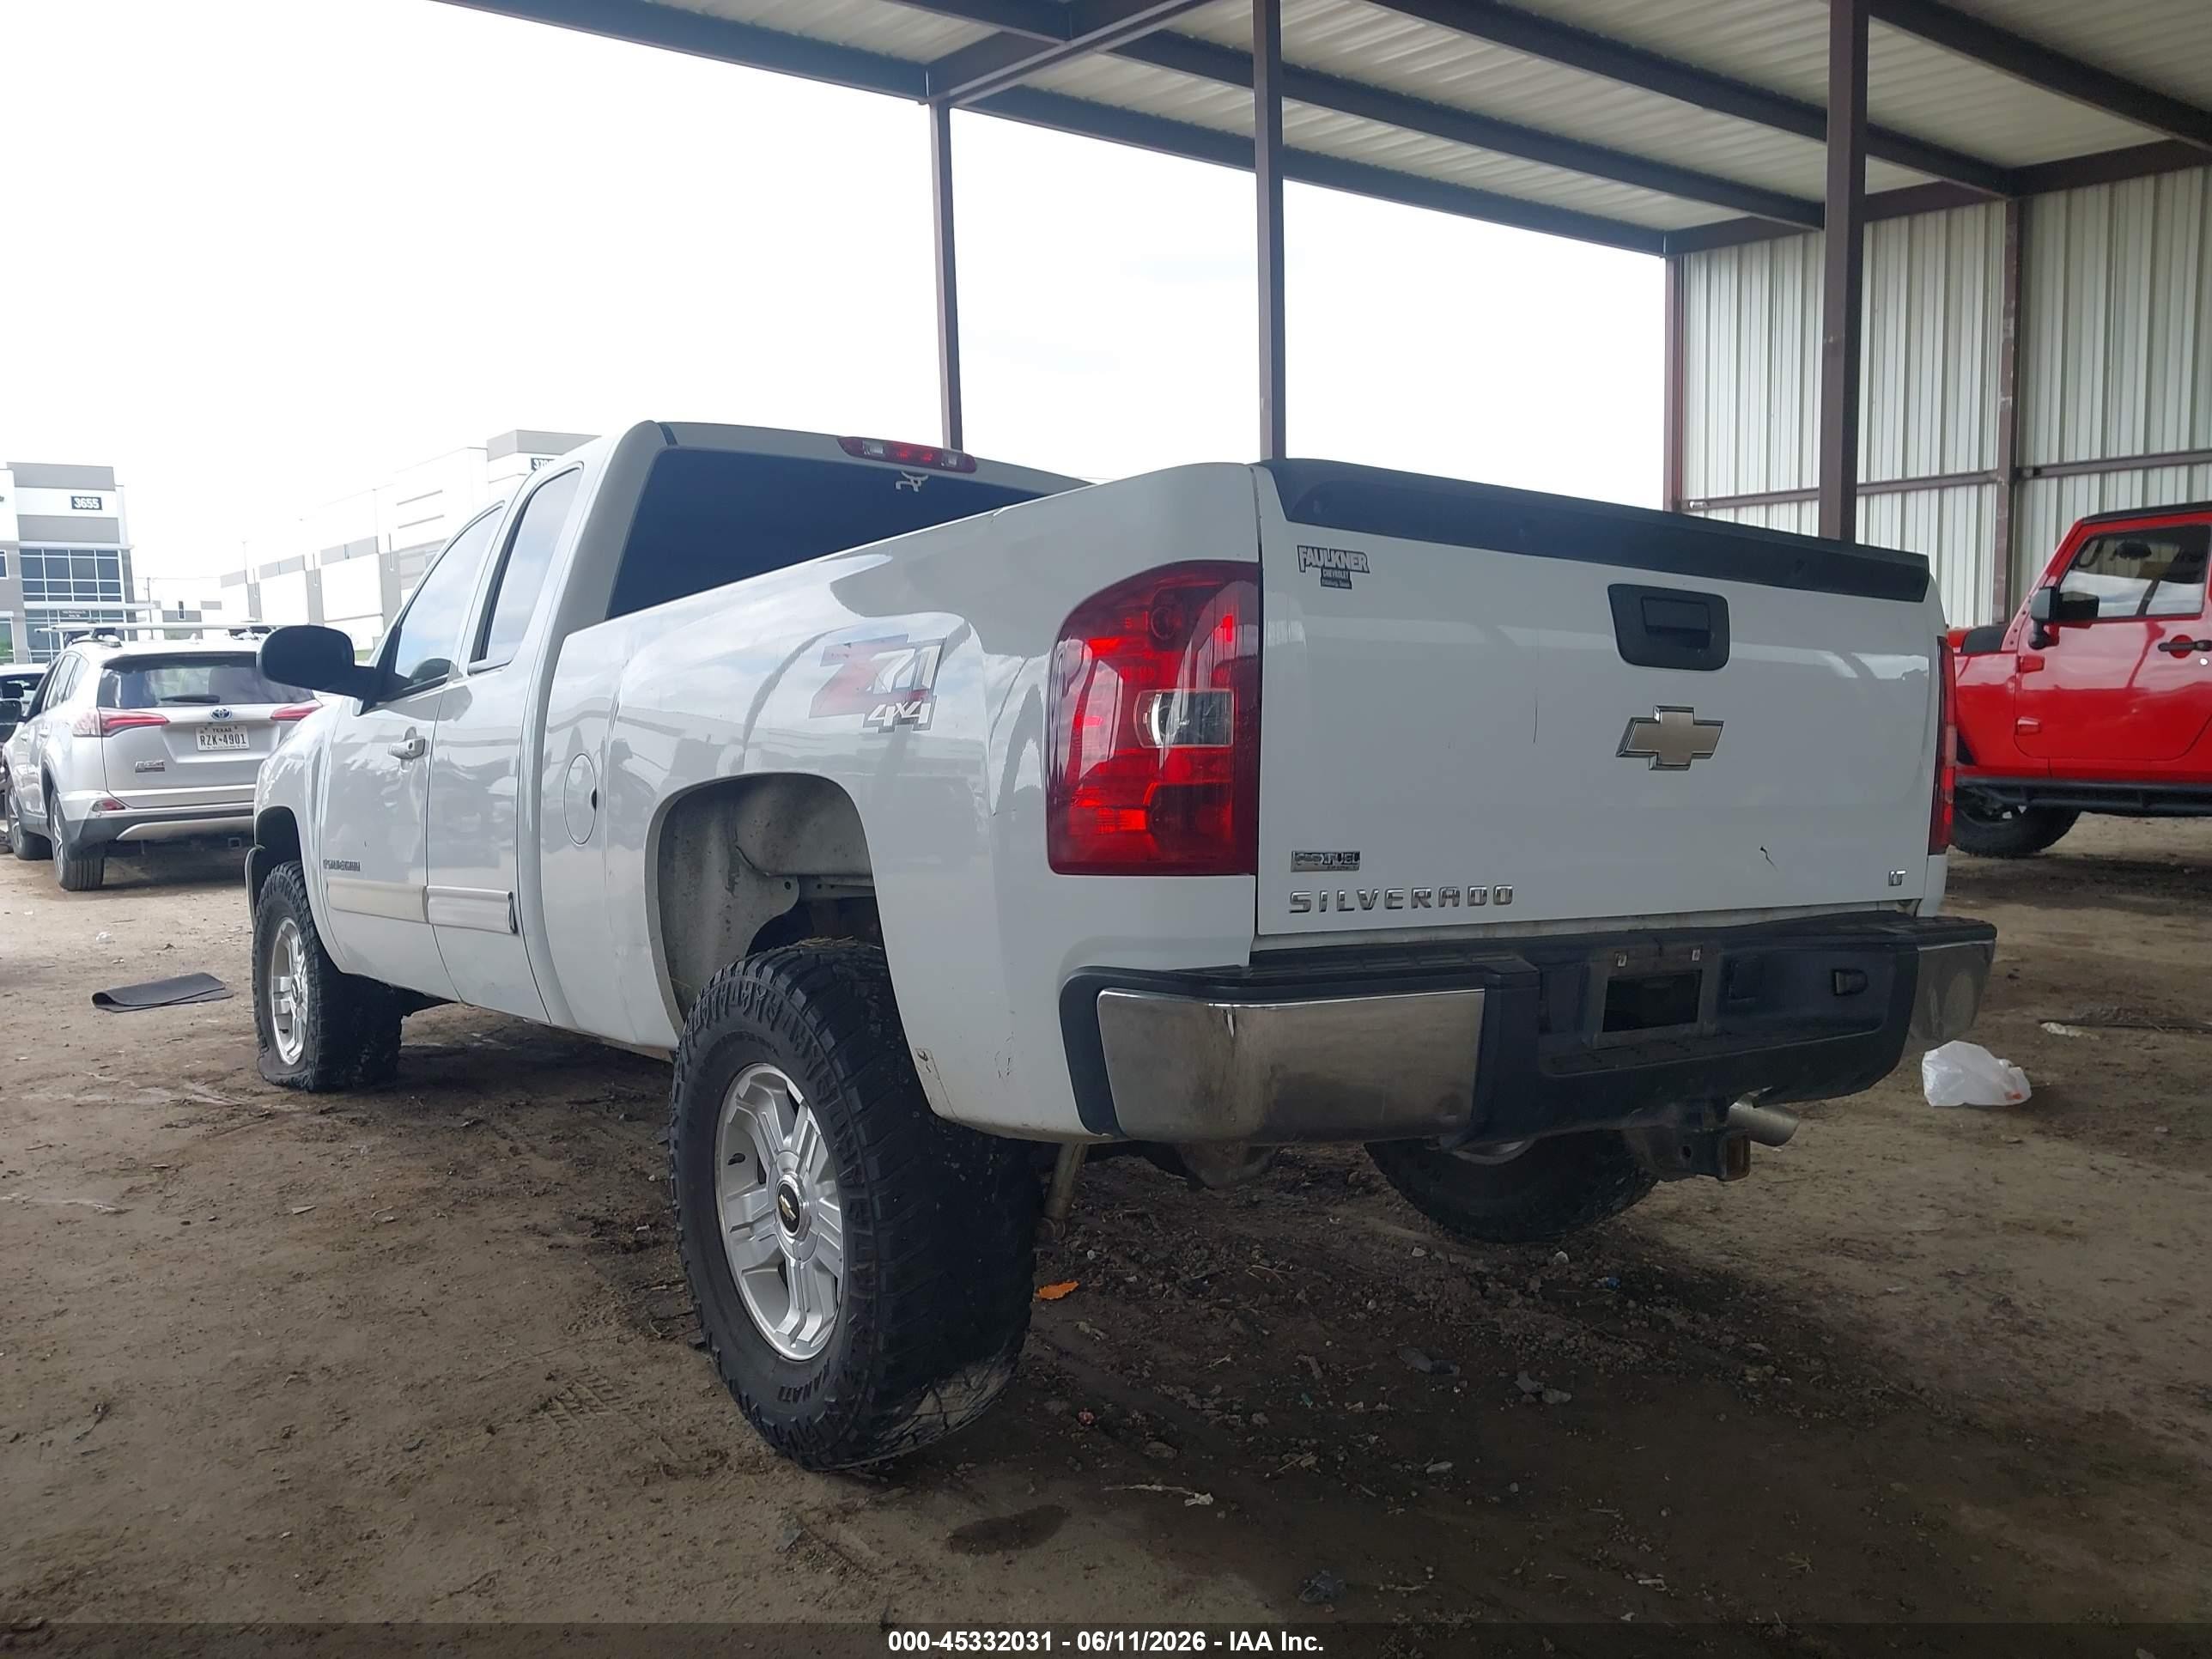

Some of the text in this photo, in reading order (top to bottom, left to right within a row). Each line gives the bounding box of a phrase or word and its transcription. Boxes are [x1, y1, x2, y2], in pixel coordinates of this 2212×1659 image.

[73, 496, 100, 509] 3655
[1297, 544, 1370, 573] FAULKNER
[809, 634, 945, 718] Z71
[1289, 884, 1514, 914] SILVERADO
